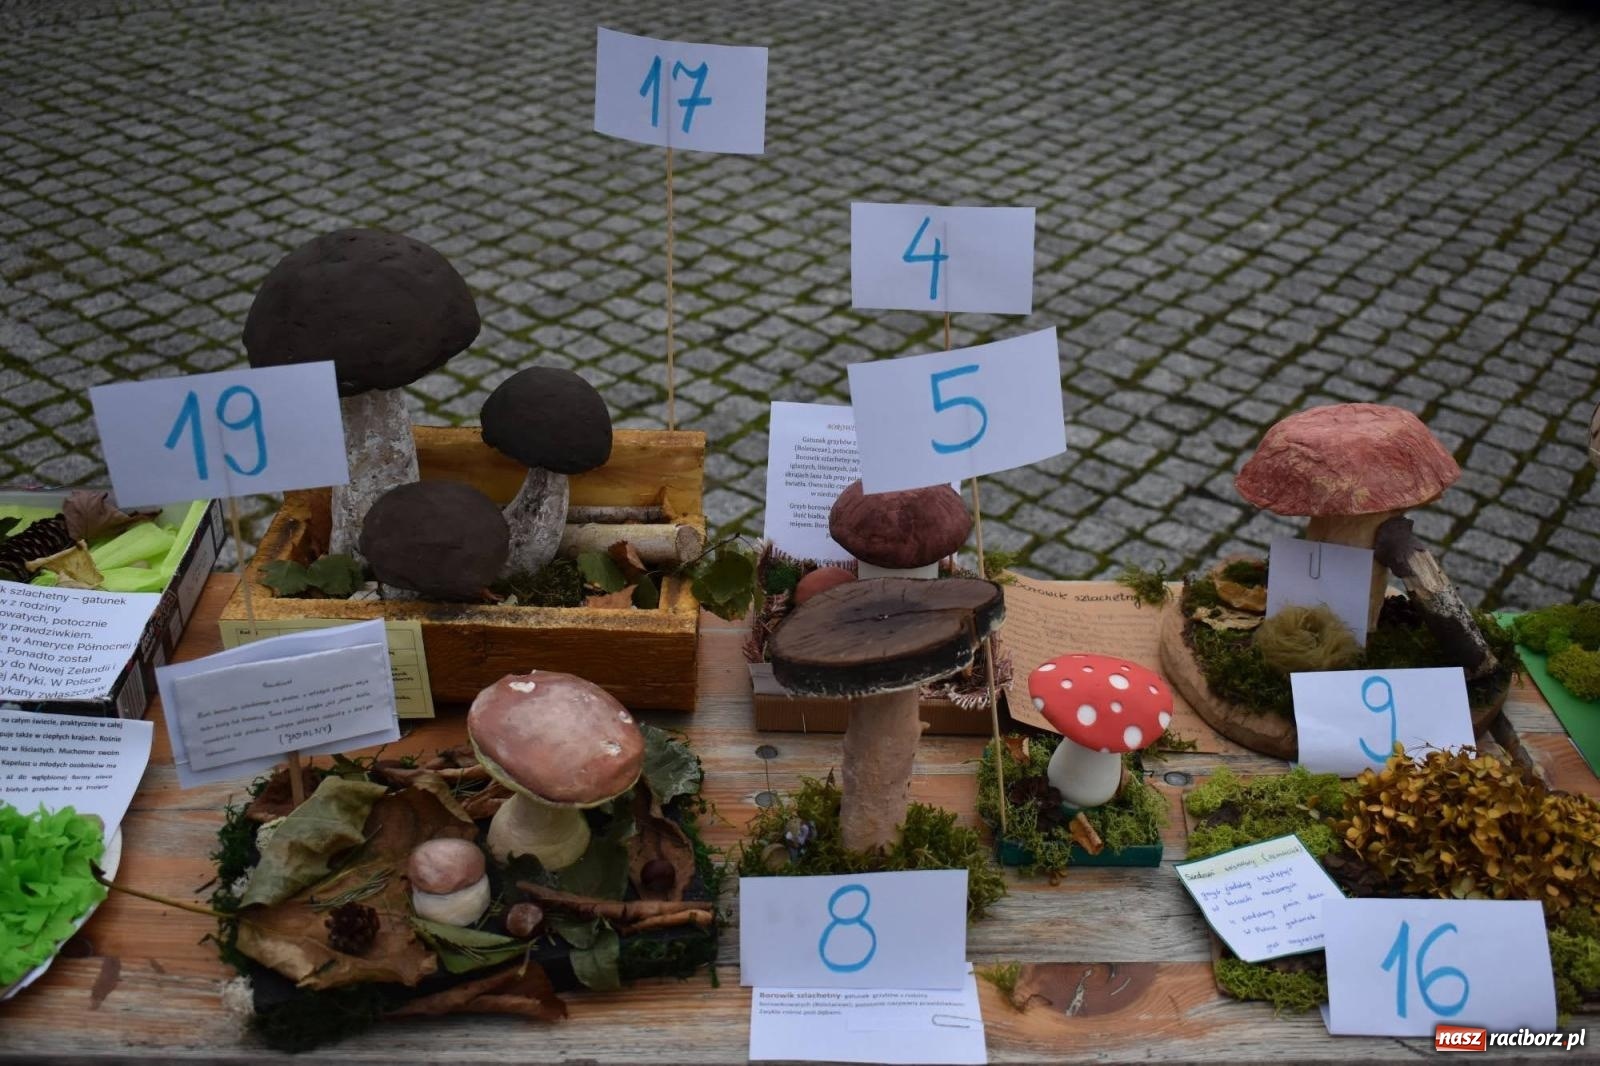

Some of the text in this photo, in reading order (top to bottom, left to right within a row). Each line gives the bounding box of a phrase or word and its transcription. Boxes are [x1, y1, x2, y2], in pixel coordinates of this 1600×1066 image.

[640, 56, 713, 133] 17
[902, 218, 948, 301] 4
[929, 364, 989, 455] 5
[165, 385, 267, 480] 19
[9, 588, 70, 603] szlachetny
[81, 596, 127, 606] gatunek
[19, 601, 61, 614] rodziny
[10, 623, 95, 640] prawdziwkiem.
[52, 618, 109, 629] potocznie
[23, 637, 75, 651] Ameryce
[76, 642, 133, 652] Północnej
[7, 647, 93, 664] Ponadto został
[10, 660, 26, 669] do
[28, 663, 66, 677] Nowej
[67, 665, 111, 676] Zelandii
[10, 673, 46, 687] Afryki.
[50, 678, 63, 687] W
[65, 677, 102, 687] Polsce
[60, 719, 98, 729] praktycznie
[107, 722, 123, 730] całej
[1359, 674, 1398, 764] 9
[43, 734, 70, 742] ciepłych
[71, 734, 97, 742] krajach.
[99, 735, 122, 743] Rośnie
[20, 746, 55, 755] liściastych.
[58, 747, 96, 755] Muchomor
[1, 759, 31, 768] Kapelusz
[38, 761, 68, 769] młodych
[69, 761, 104, 769] osobników
[818, 883, 878, 975] 8
[1380, 921, 1471, 1020] 16
[759, 992, 794, 1000] Borowik
